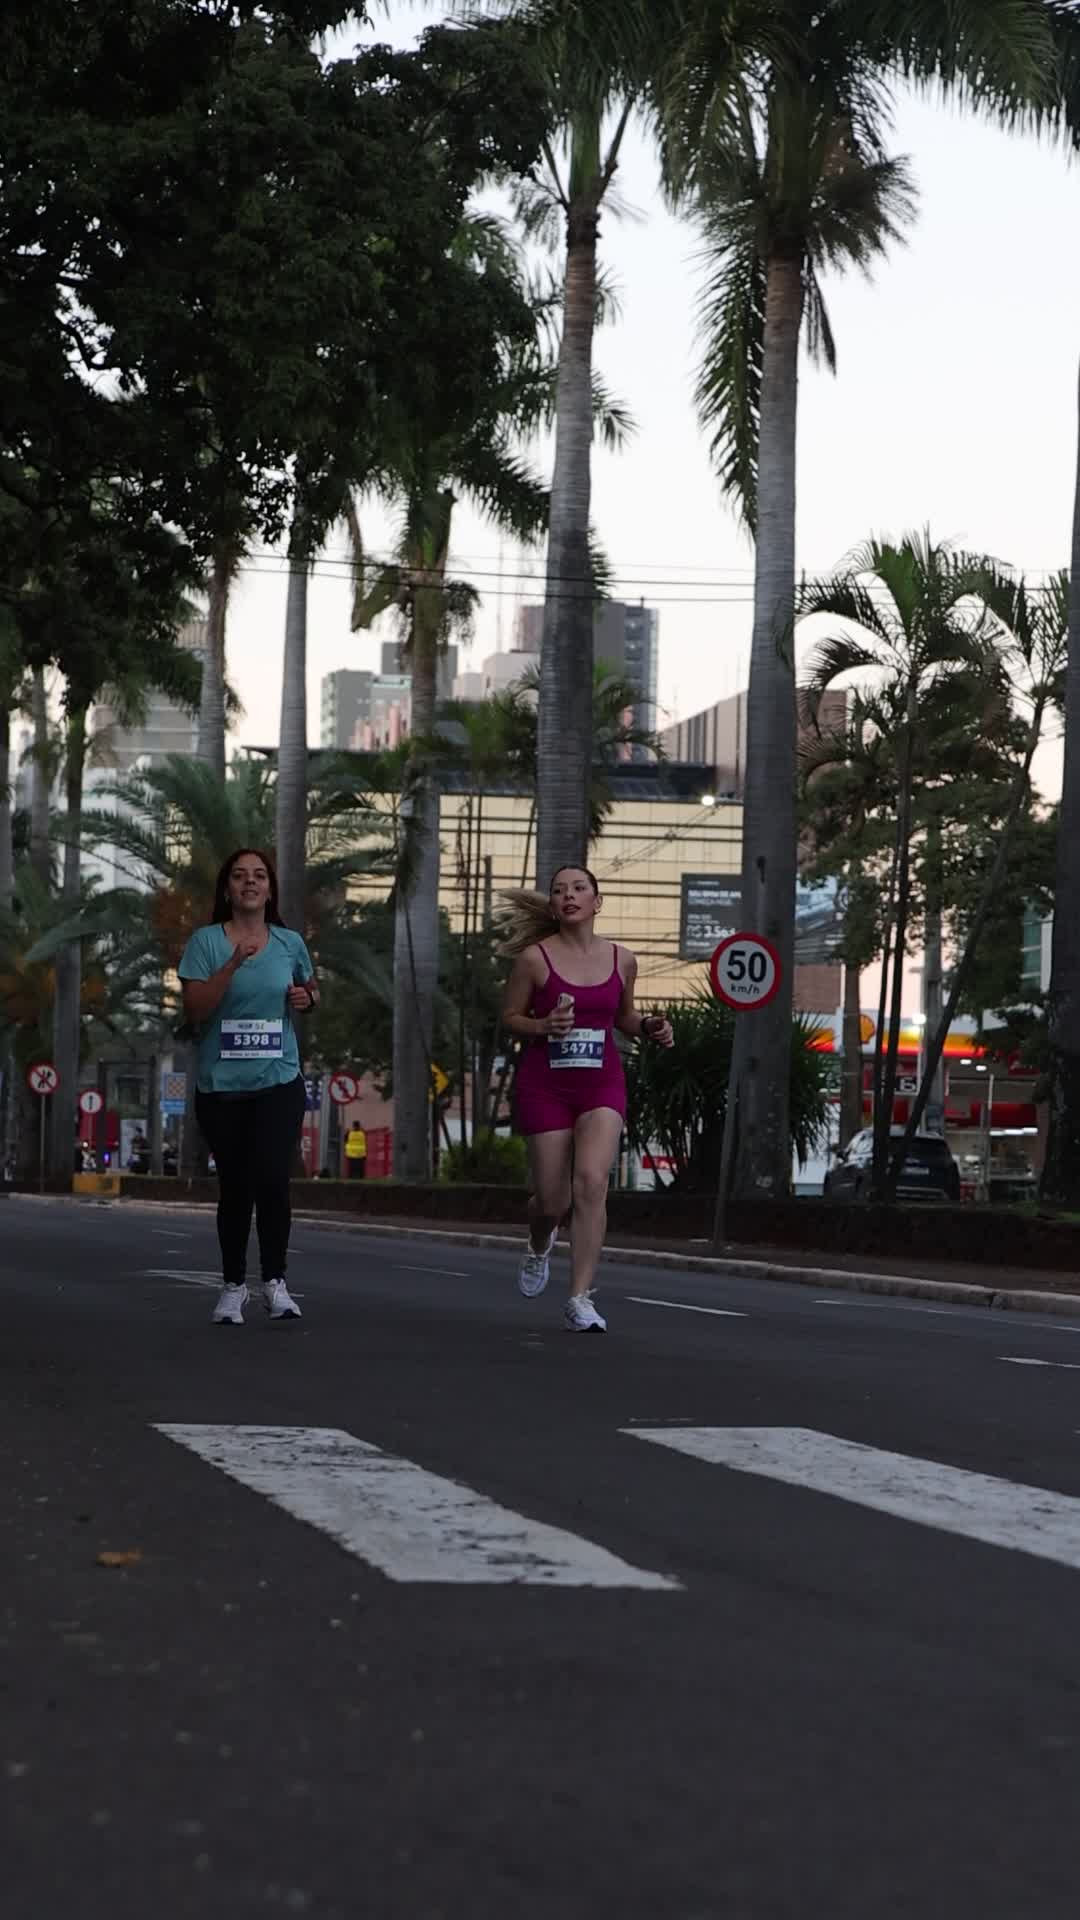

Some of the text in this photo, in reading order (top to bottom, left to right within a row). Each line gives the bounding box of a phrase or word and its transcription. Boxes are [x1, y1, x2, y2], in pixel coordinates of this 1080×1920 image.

[727, 950, 767, 983] 50
[731, 983, 760, 995] km/h
[233, 1034, 269, 1046] 5398
[561, 1042, 594, 1055] 5471
